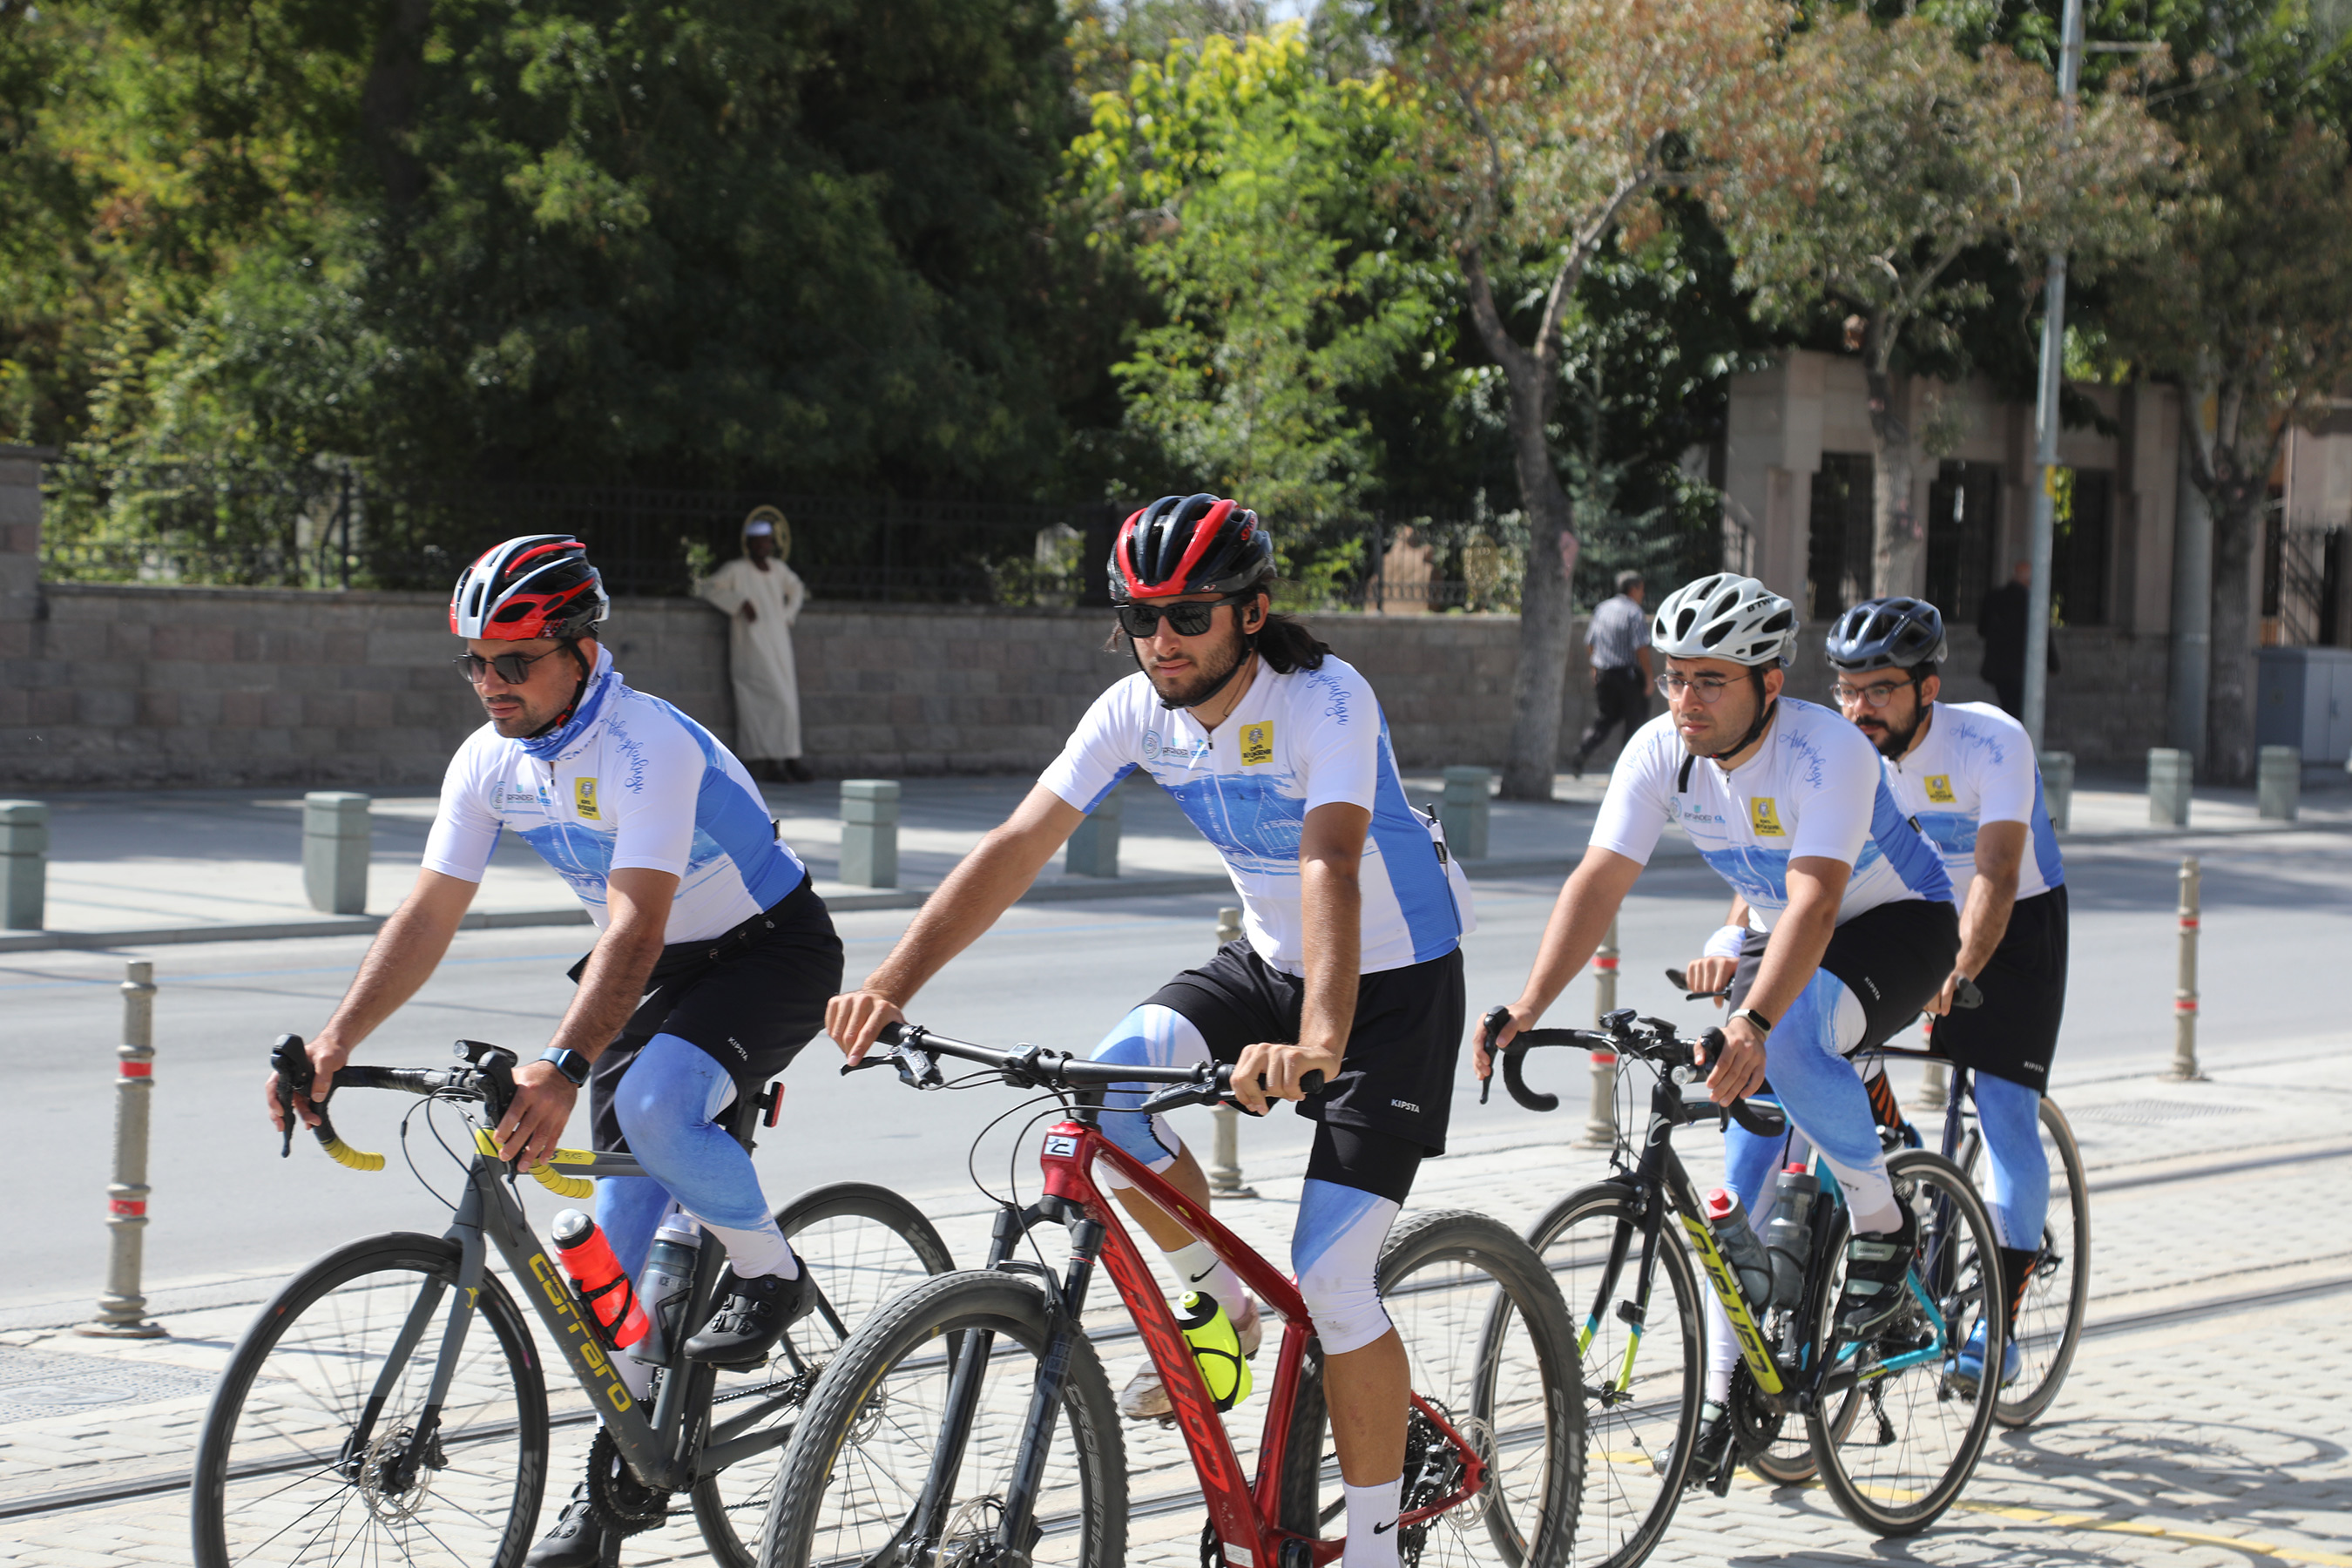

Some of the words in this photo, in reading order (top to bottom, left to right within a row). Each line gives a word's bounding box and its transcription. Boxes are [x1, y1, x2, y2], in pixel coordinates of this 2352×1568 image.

[727, 1037, 748, 1061] KIPSTA
[2024, 1060, 2044, 1073] KIPSTA
[1390, 1098, 1421, 1113] KIPSTA
